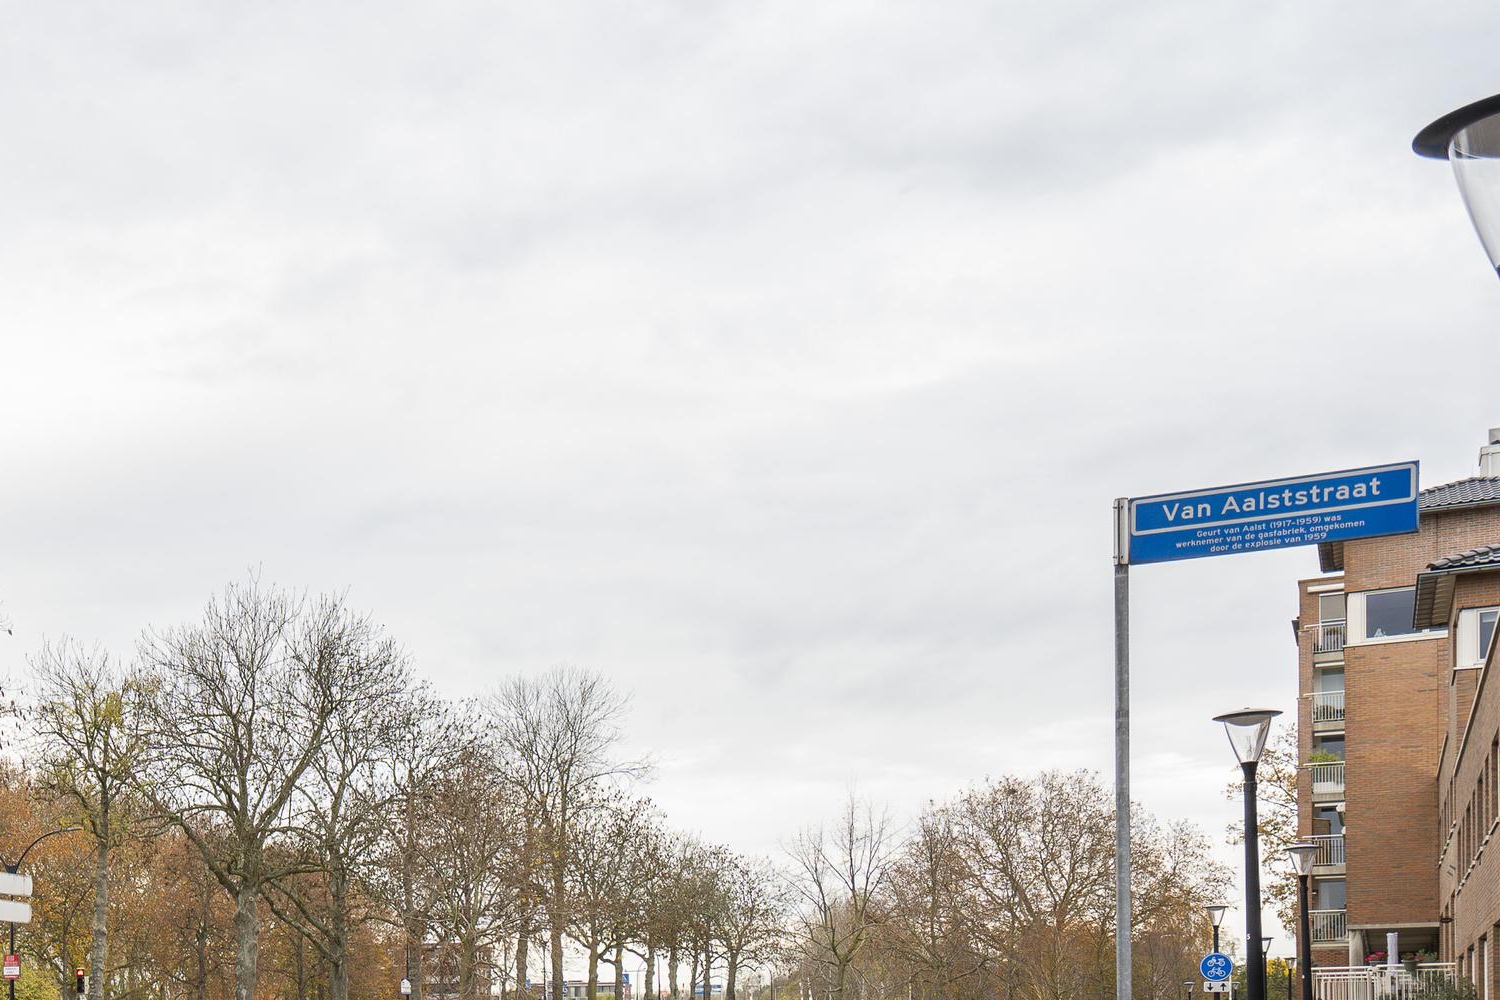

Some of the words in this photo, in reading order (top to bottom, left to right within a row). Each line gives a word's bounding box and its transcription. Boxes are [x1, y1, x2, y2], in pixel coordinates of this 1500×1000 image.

[1162, 502, 1211, 521] Van
[1221, 477, 1381, 515] Aalststraat
[1175, 537, 1225, 548] werknemer
[1245, 532, 1256, 540] de
[1258, 527, 1307, 540] gasfabriek,
[1309, 520, 1365, 532] omgekomen
[1196, 529, 1221, 538] Geurt
[1242, 523, 1266, 532] Aalst
[1269, 516, 1322, 529] (1917-1959)
[1323, 514, 1342, 522] was
[1210, 544, 1229, 552] door
[1232, 542, 1242, 550] de
[1245, 538, 1281, 548] explosie
[1284, 536, 1301, 544] van
[1304, 532, 1327, 541] 1959
